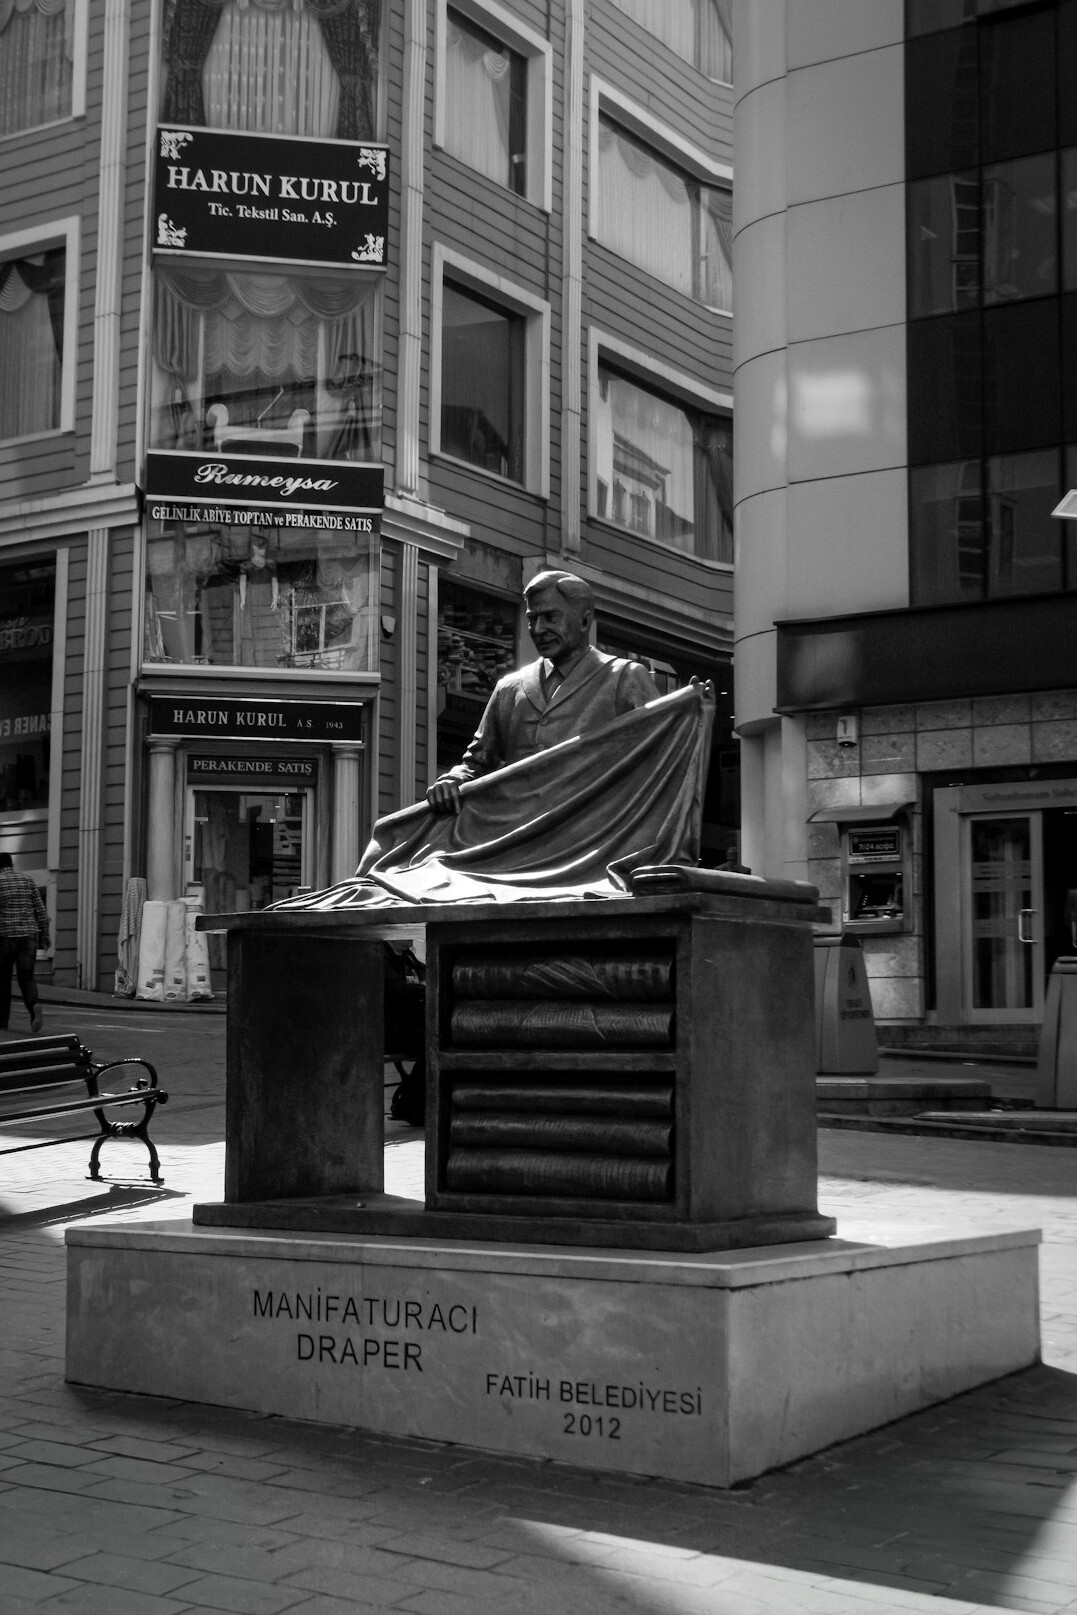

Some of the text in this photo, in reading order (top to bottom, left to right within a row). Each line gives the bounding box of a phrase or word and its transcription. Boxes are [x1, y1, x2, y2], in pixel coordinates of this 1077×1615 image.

[166, 165, 379, 206] HARUN KURUL
[208, 202, 337, 228] Tic. Tekstil San. A.Ş.
[193, 463, 339, 497] Rumeysa
[152, 505, 373, 534] GELİNLİK ABİYE TOPTAN ve PERAKENDE SATIŞ
[172, 709, 229, 725] HARUN
[235, 711, 287, 727] KURUL
[326, 721, 344, 729] 1943
[193, 760, 312, 775] PERAKENDE SATIŞ
[253, 1287, 477, 1334] MANİFATURACI
[297, 1333, 423, 1372] DRAPER
[486, 1371, 702, 1416] FATİH BELEDİYESİ
[564, 1412, 621, 1440] 2012
